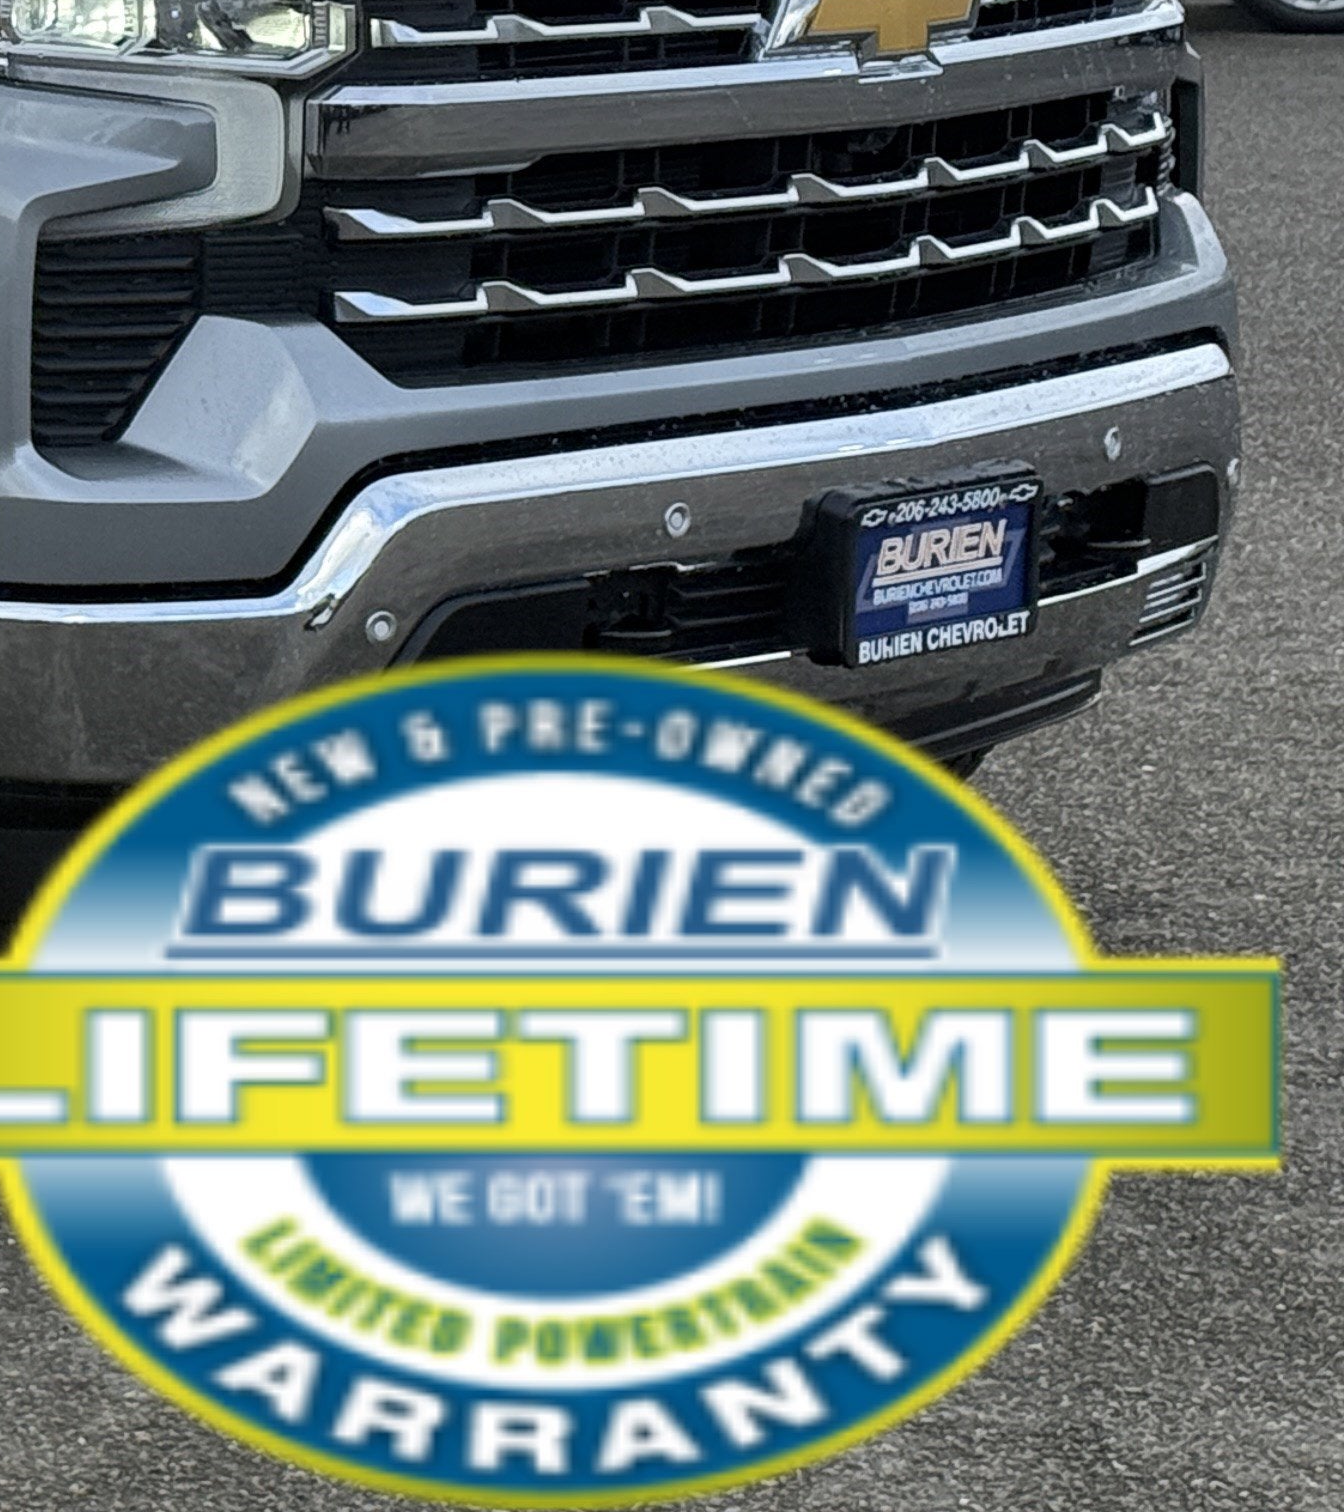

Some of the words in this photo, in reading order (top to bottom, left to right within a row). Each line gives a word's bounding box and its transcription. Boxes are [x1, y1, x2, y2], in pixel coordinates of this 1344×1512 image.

[895, 486, 1001, 523] 206-243-5800
[876, 518, 1008, 576] BURIEN
[927, 609, 1031, 649] CHEVROLET
